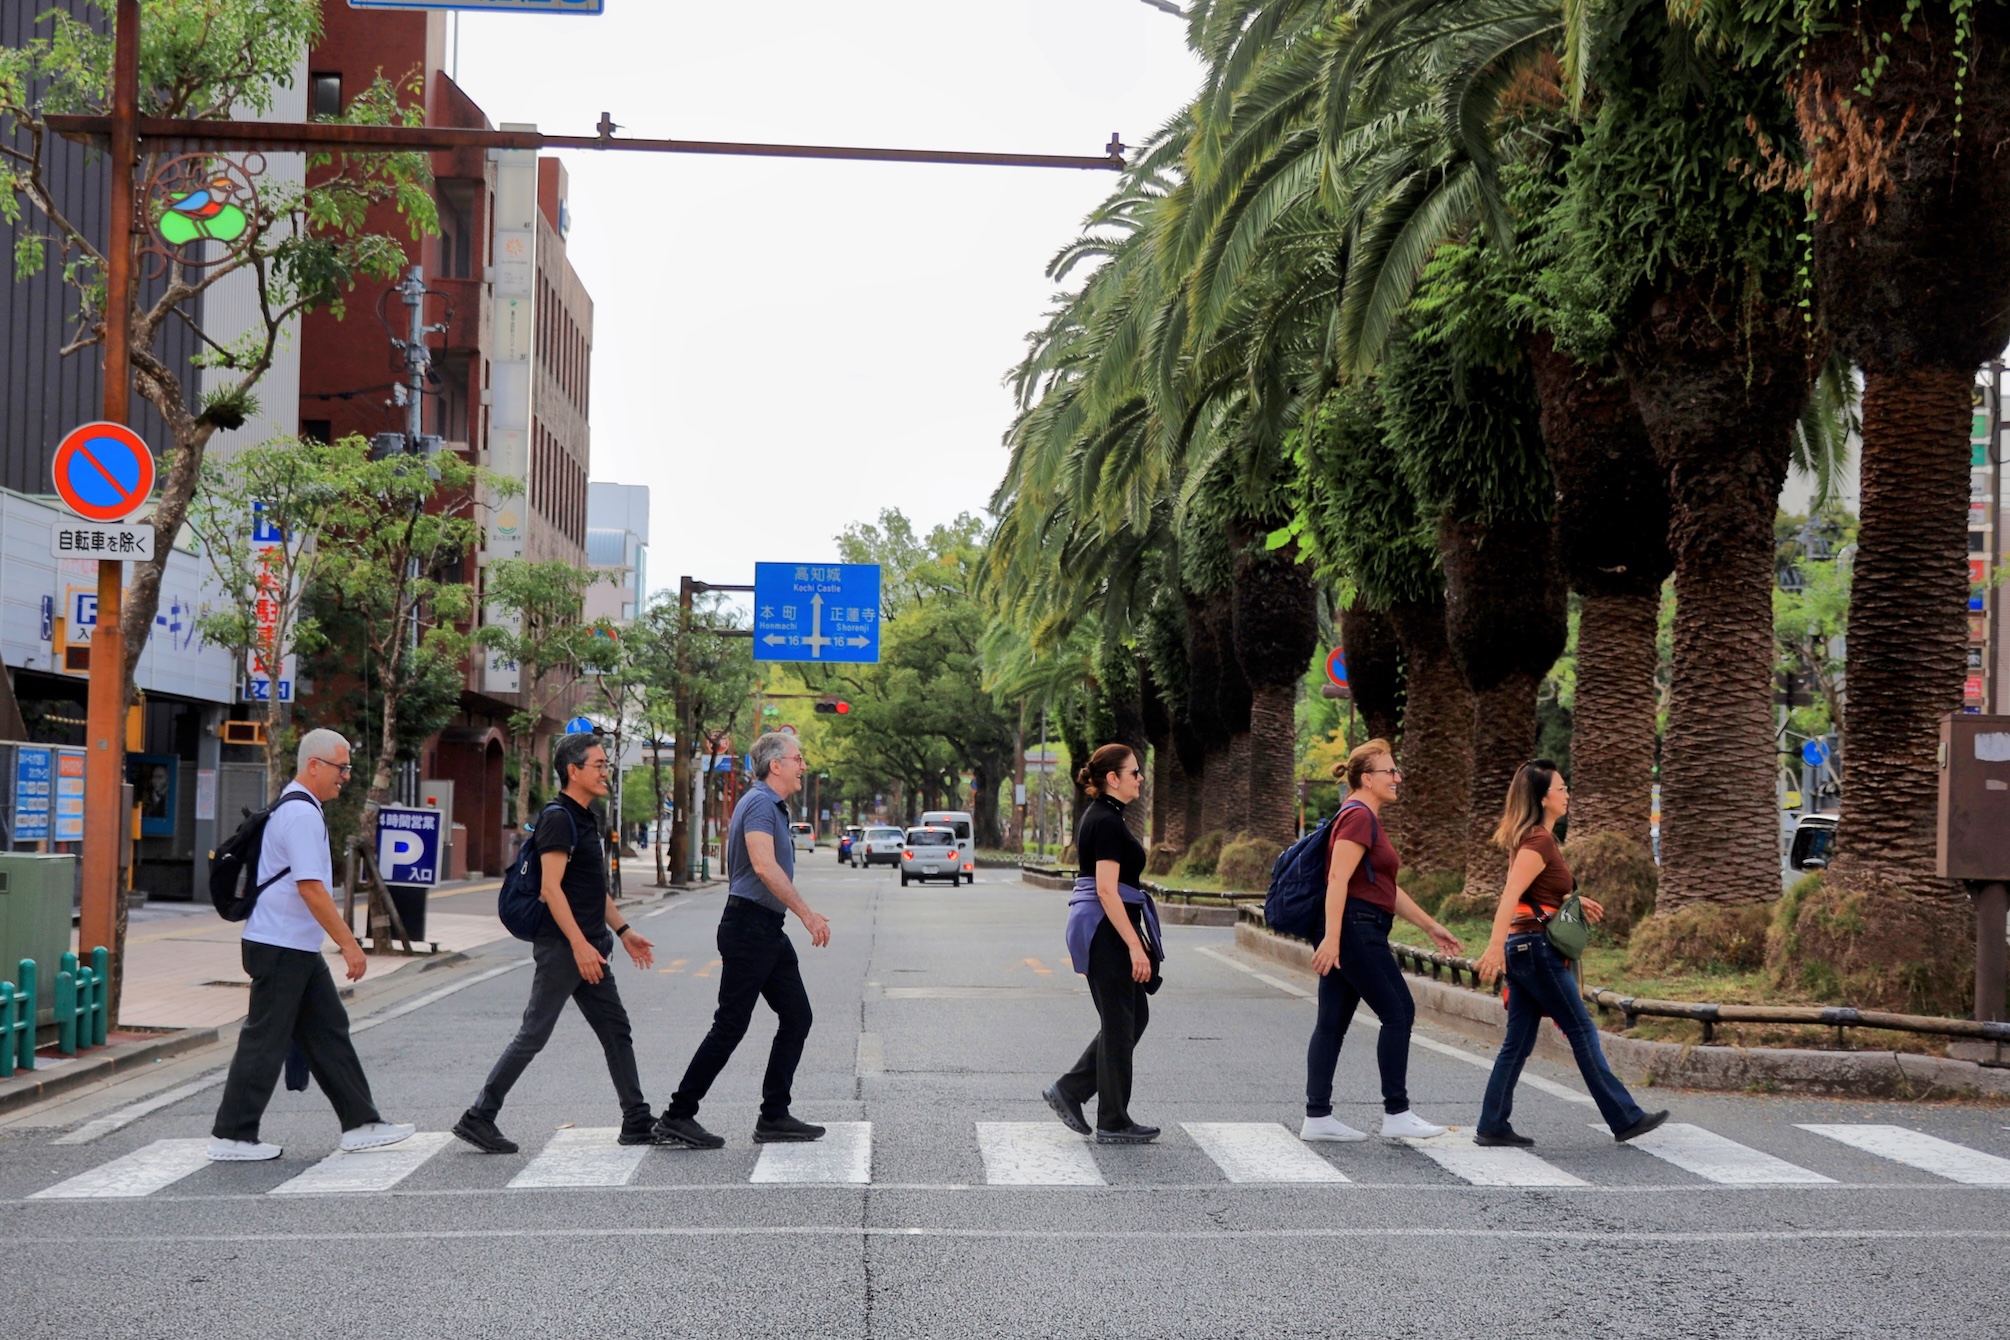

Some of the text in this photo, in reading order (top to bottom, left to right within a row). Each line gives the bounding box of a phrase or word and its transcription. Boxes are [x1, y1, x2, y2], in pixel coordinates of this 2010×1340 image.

[59, 530, 145, 553] 自転車を除く
[795, 566, 842, 582] 高知城
[793, 583, 841, 593] Kochi Castle
[760, 605, 797, 621] 本町
[830, 607, 876, 623] 正蓮寺
[760, 621, 797, 630] Honmachi
[836, 623, 870, 633] Shorenji
[78, 627, 89, 640] 入
[788, 635, 800, 646] 16
[833, 636, 845, 647] 16
[380, 813, 436, 830] 4時間営業
[379, 829, 425, 880] P
[408, 867, 433, 882] 入口
